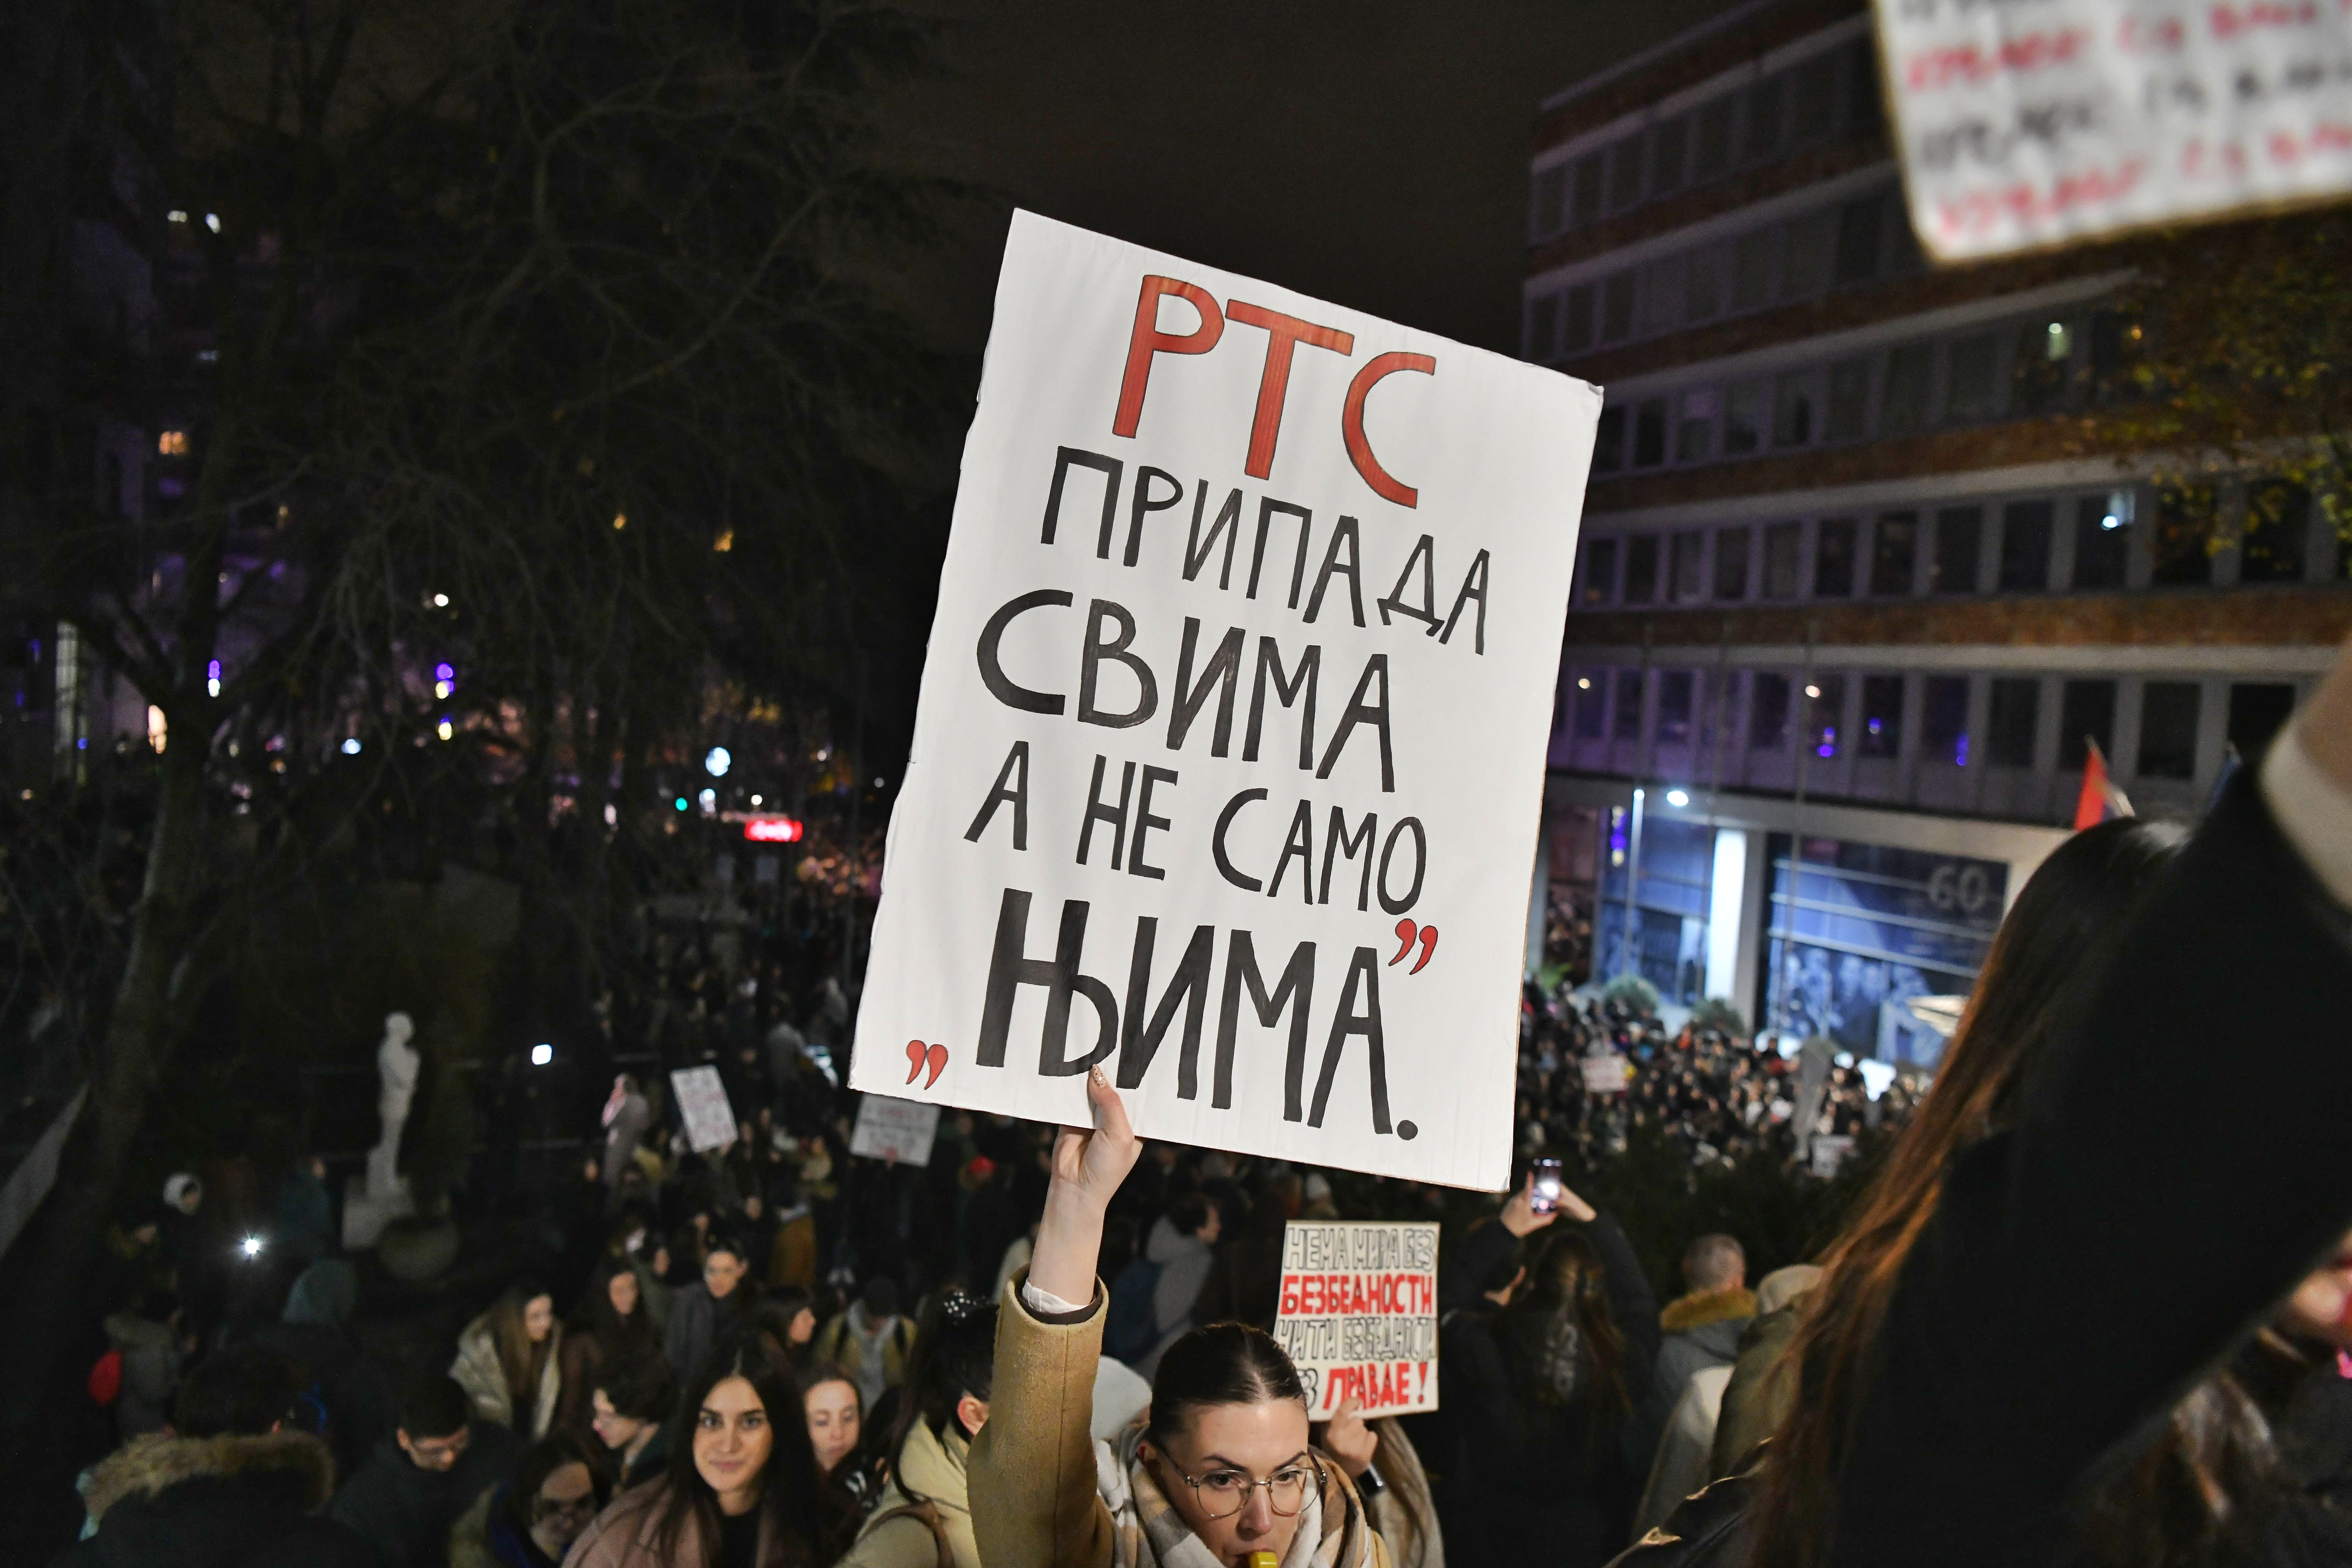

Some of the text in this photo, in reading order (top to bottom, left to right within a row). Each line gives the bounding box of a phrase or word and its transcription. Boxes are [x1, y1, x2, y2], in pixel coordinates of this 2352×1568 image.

[1112, 274, 1437, 510] РТС
[1040, 445, 1490, 656] ПРИПАДА
[976, 588, 1396, 793] СВИМА
[963, 740, 1427, 916] А НЕ САМО
[1280, 1273, 1433, 1315] БЕЗБЕДНОСТИ
[1284, 1227, 1436, 1272] НЕМА МИРА БЕЗ
[1274, 1318, 1338, 1360] НИТИ
